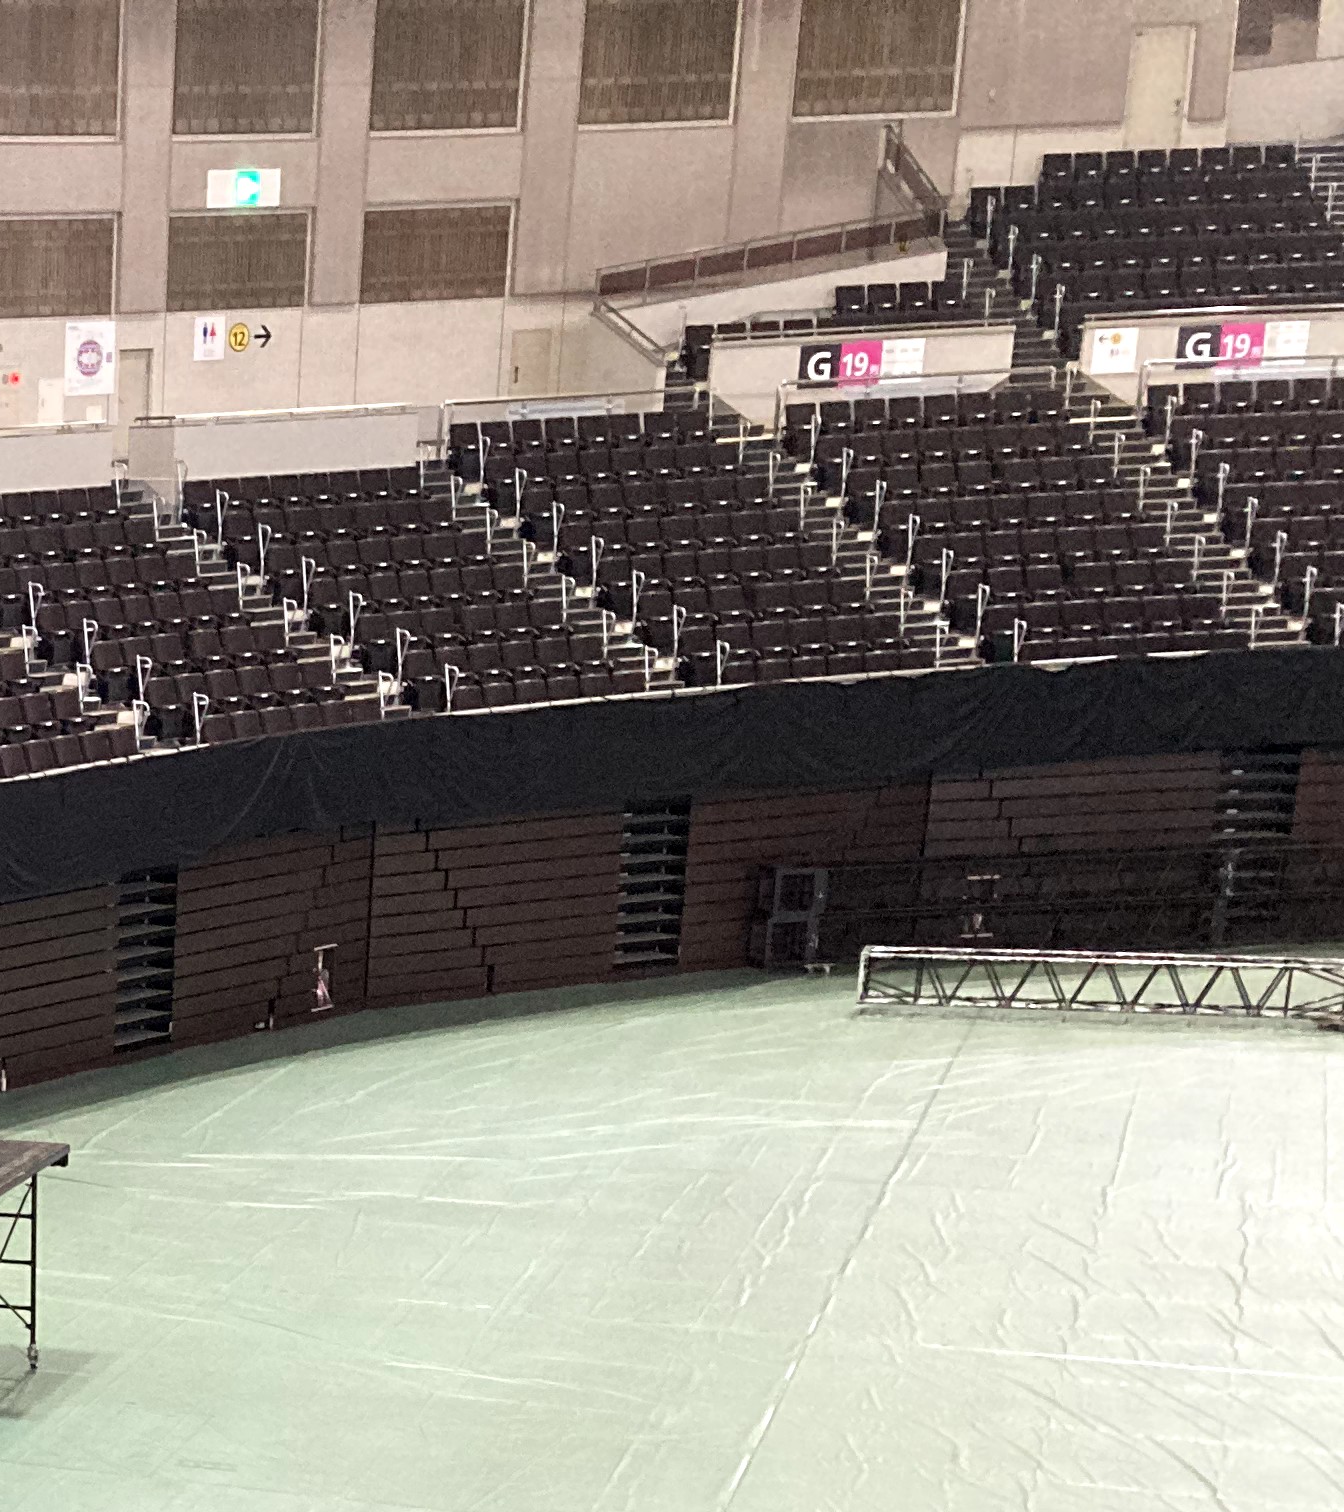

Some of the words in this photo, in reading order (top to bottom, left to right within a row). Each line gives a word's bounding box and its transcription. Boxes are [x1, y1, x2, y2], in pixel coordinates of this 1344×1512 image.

[233, 331, 246, 346] 12
[1185, 332, 1212, 359] G
[807, 351, 832, 380] G
